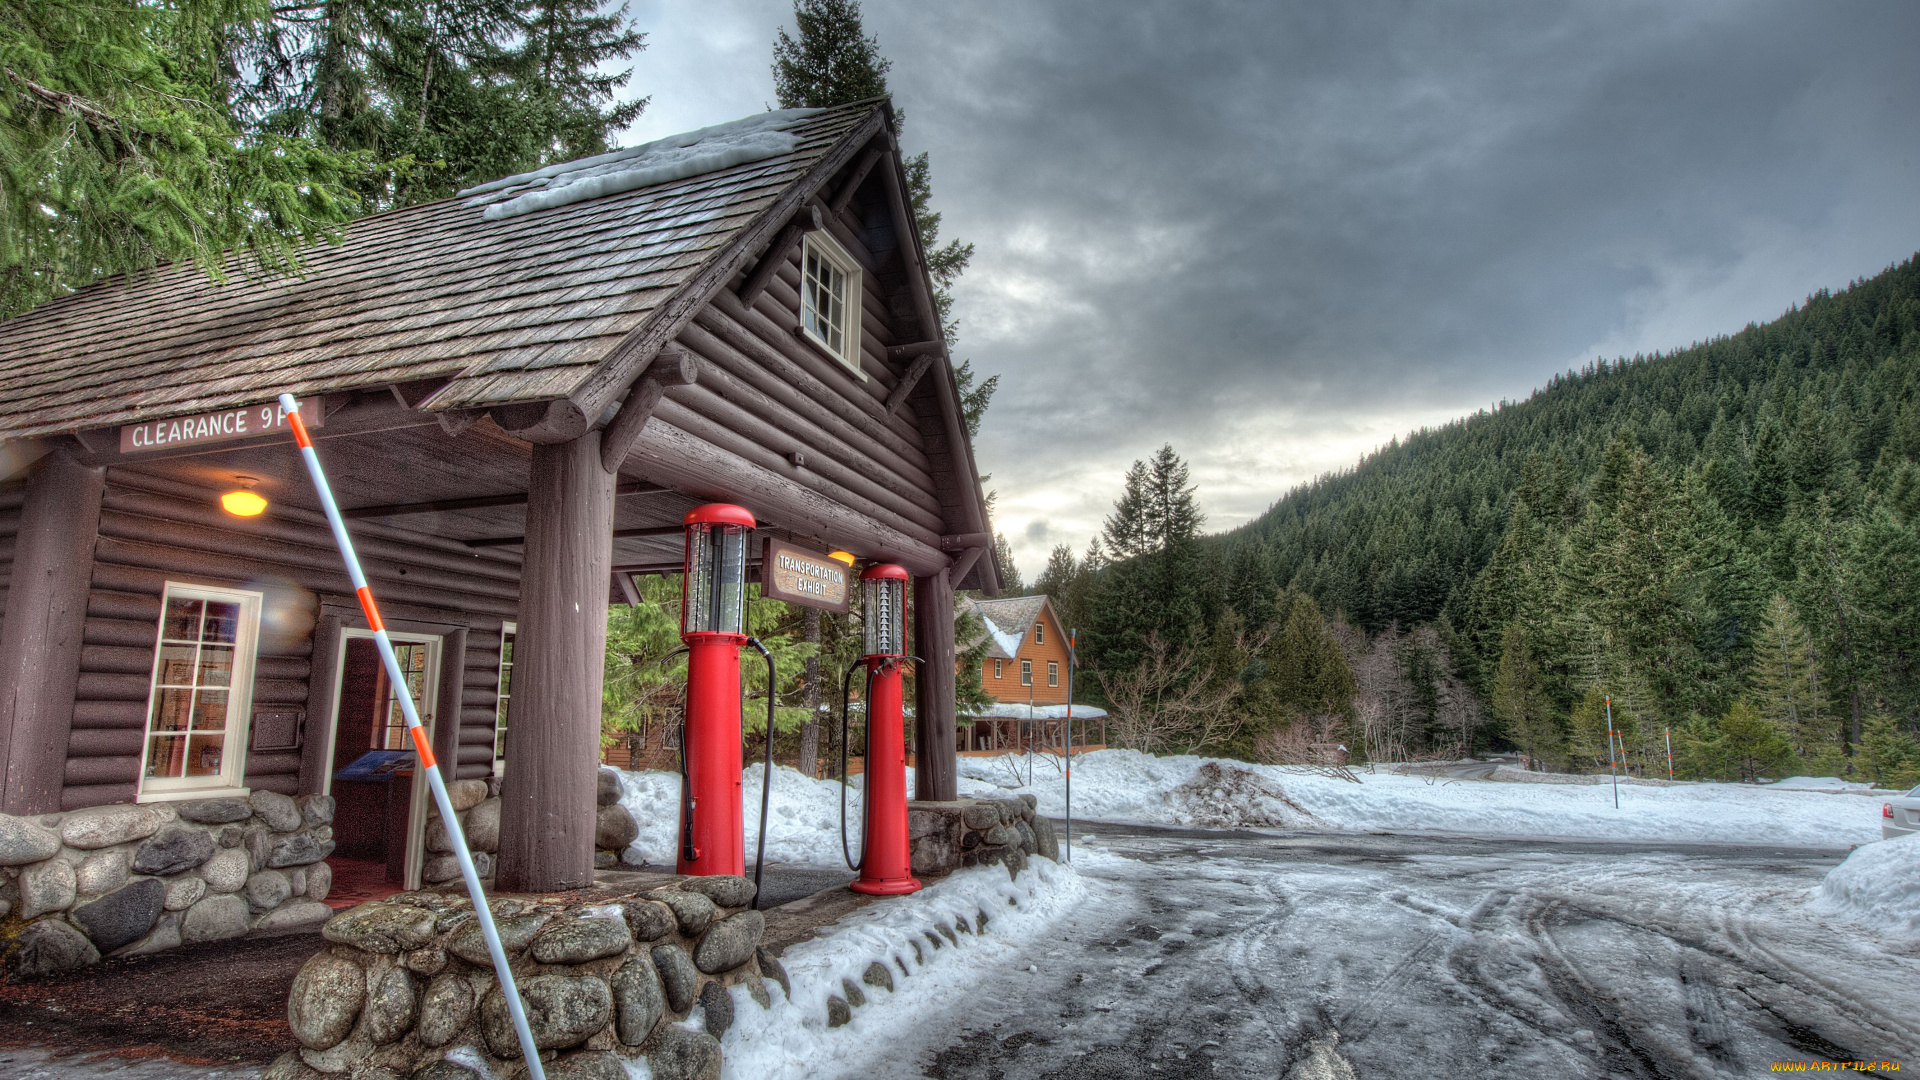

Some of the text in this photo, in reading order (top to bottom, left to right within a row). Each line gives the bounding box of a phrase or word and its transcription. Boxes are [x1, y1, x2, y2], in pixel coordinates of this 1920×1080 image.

[132, 401, 303, 447] CLEARANCE 9 F
[779, 554, 843, 584] TRANSPORTATION
[797, 577, 827, 596] EXHIBIT
